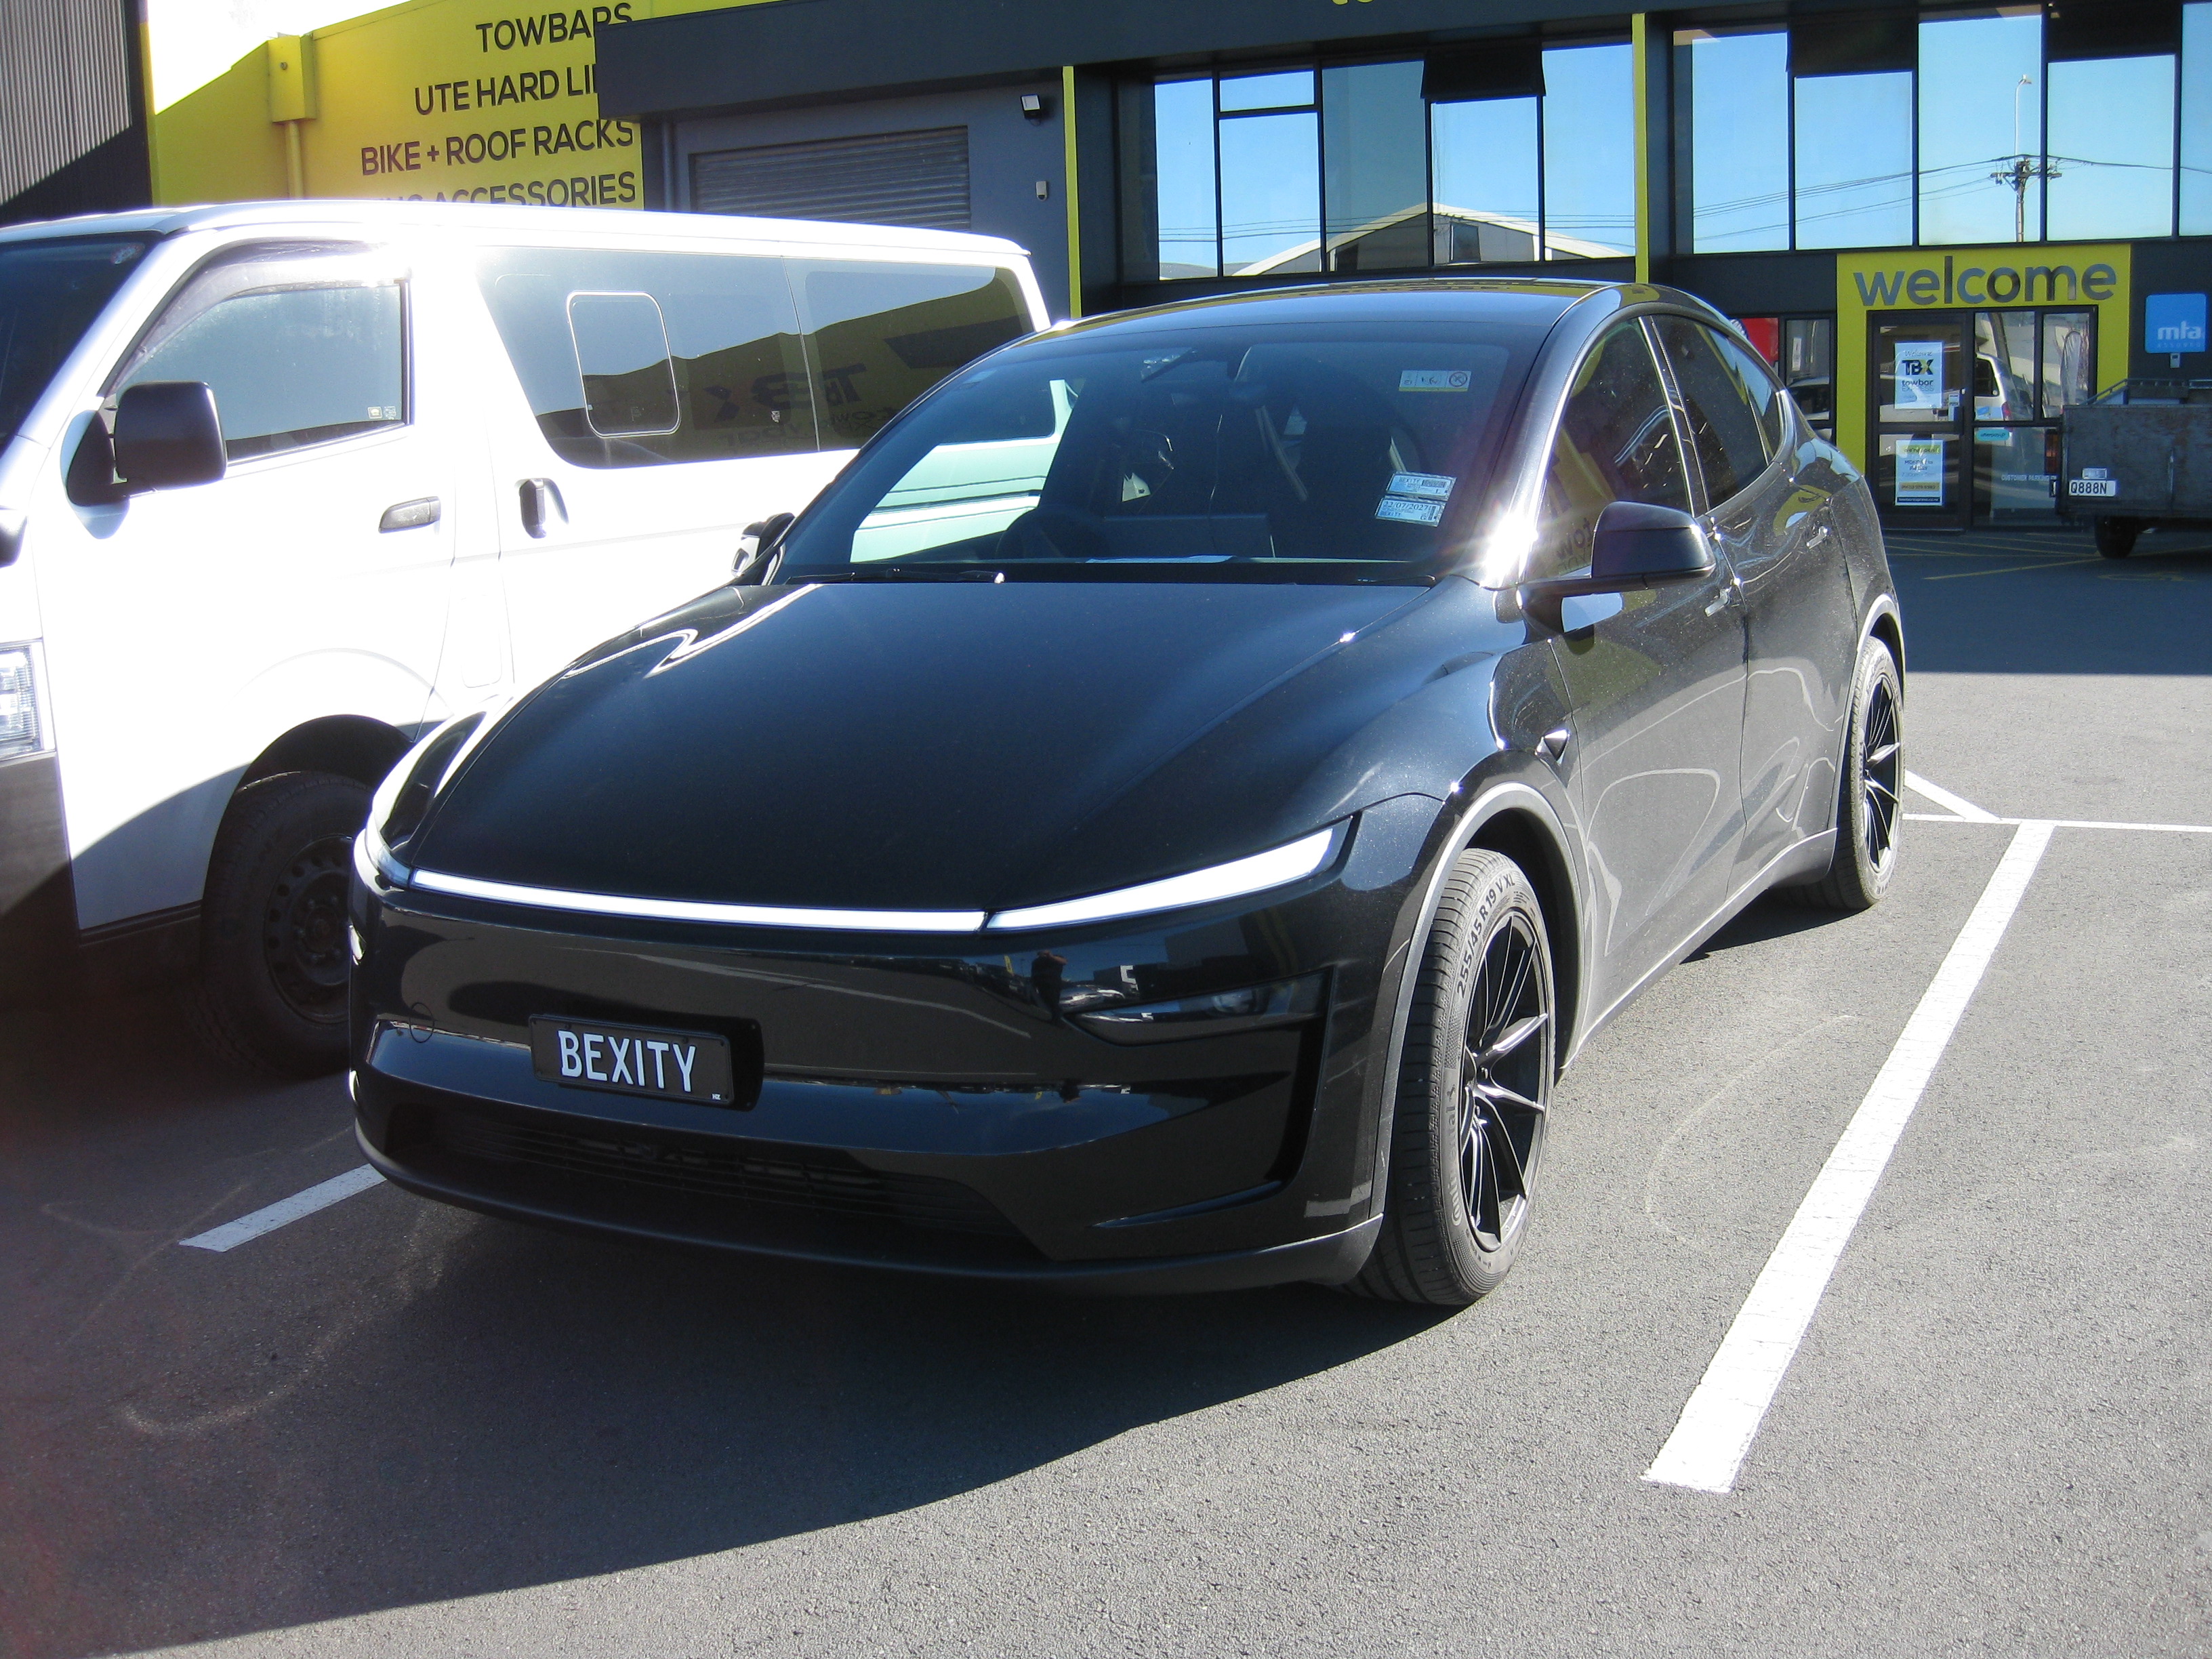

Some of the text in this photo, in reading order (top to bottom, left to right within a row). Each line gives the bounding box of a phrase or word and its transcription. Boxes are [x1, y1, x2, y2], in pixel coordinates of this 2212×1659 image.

[415, 81, 470, 115] UTE
[476, 70, 560, 108] HARD
[361, 120, 633, 176] BIKE + ROOF RACKS
[1853, 255, 2116, 306] welcome
[2157, 321, 2202, 340] mta
[1902, 359, 1933, 375] TBX
[1457, 918, 1483, 998] 255/45
[557, 1029, 696, 1092] BEXITY
